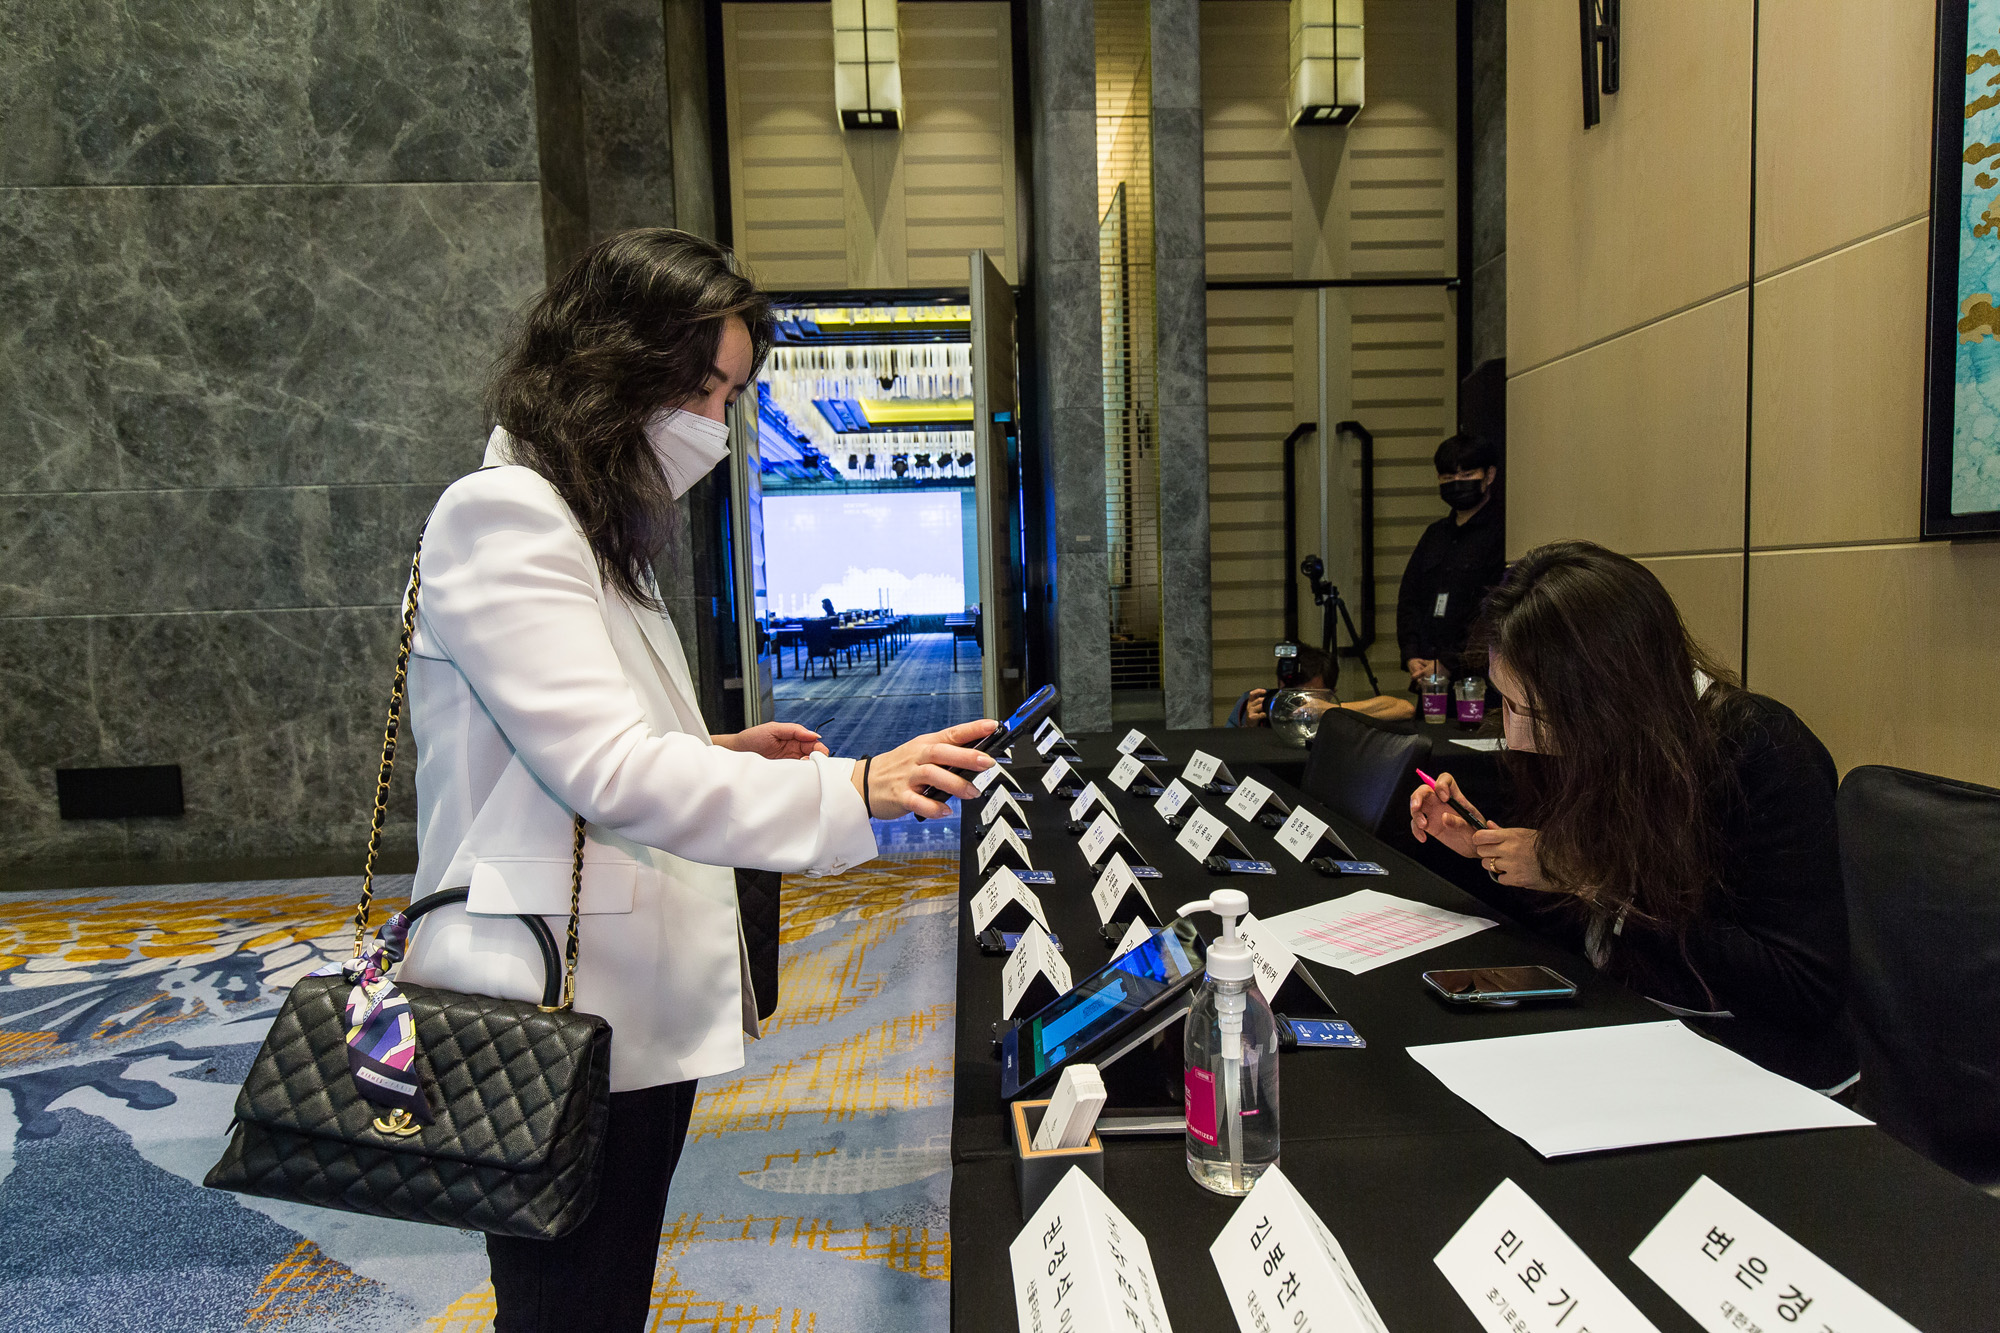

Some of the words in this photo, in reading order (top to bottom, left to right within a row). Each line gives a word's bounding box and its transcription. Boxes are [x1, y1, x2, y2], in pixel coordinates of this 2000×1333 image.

[1027, 1279, 1043, 1333] 산돌타이포
[1042, 1215, 1074, 1309] 권경석
[1250, 1215, 1301, 1310] 김봉찬
[1494, 1229, 1578, 1327] 민호기
[1701, 1226, 1813, 1323] 변은경
[1486, 1287, 1531, 1333] 호기로운
